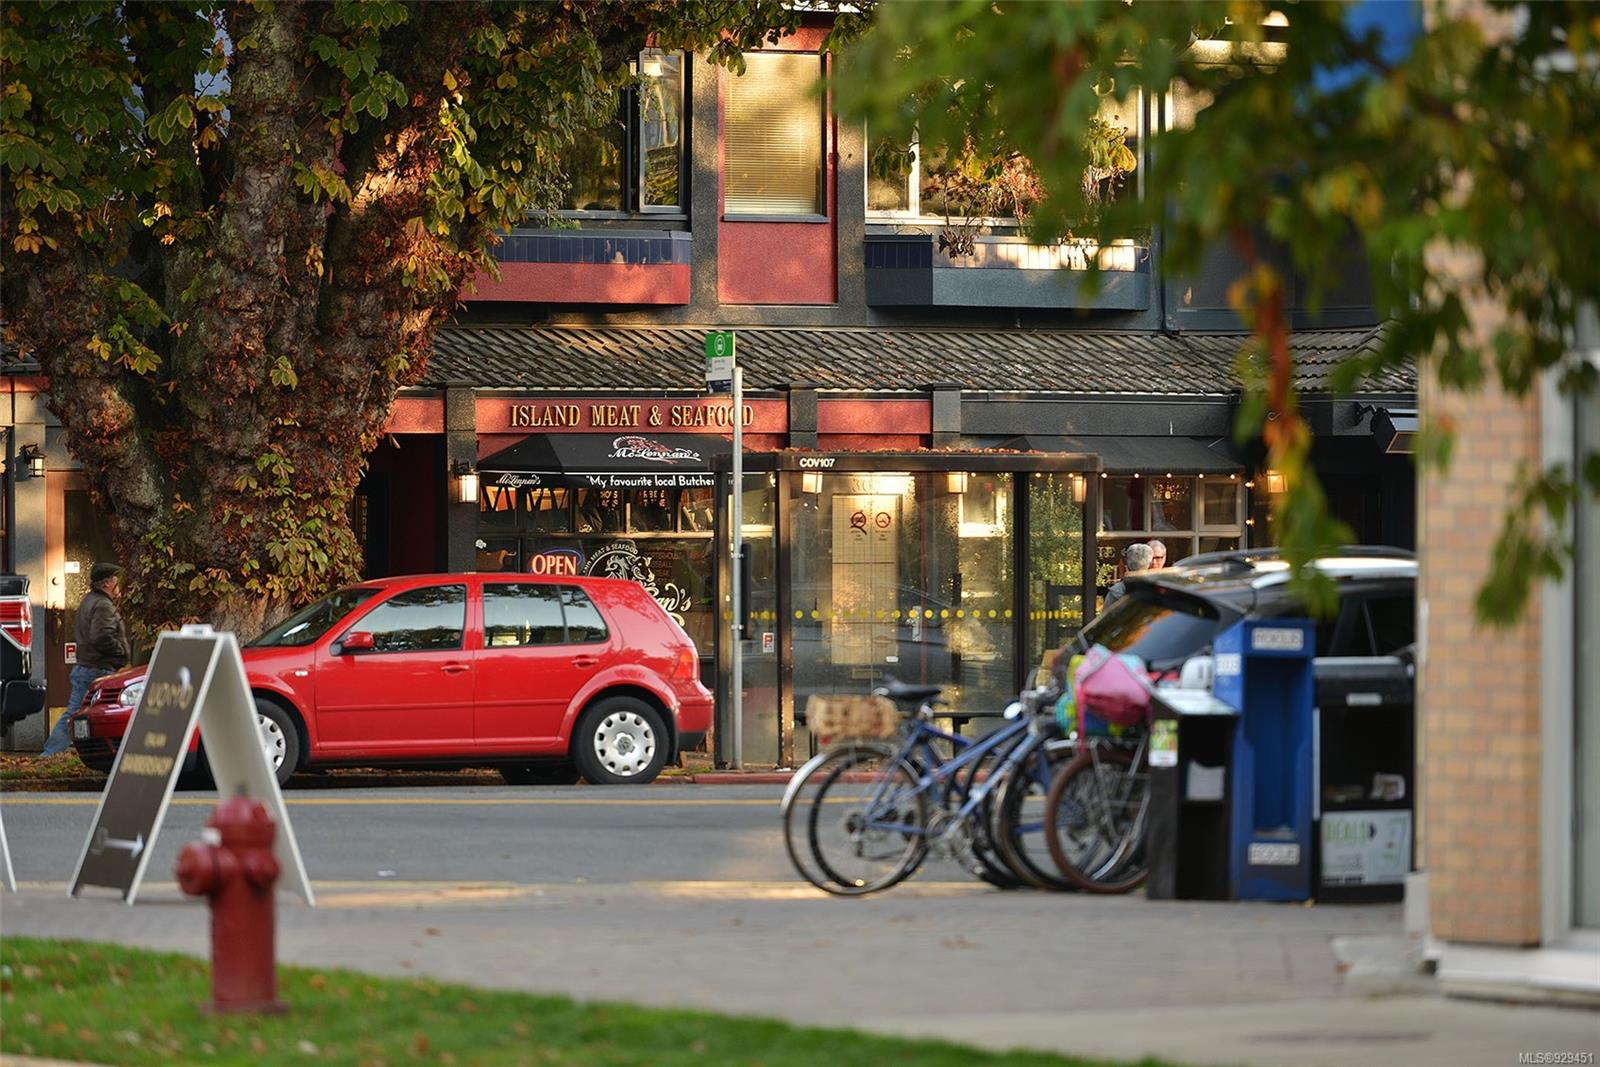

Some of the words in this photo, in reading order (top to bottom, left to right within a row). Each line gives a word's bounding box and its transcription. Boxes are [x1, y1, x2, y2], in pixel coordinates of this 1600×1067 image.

[511, 405, 581, 426] ISLAND
[591, 405, 641, 426] MEAT
[649, 405, 663, 426] &
[799, 457, 836, 468] COV107
[610, 475, 652, 487] favourite
[655, 475, 677, 487] local
[611, 543, 639, 555] SEAFOOD
[532, 554, 577, 576] OPEN
